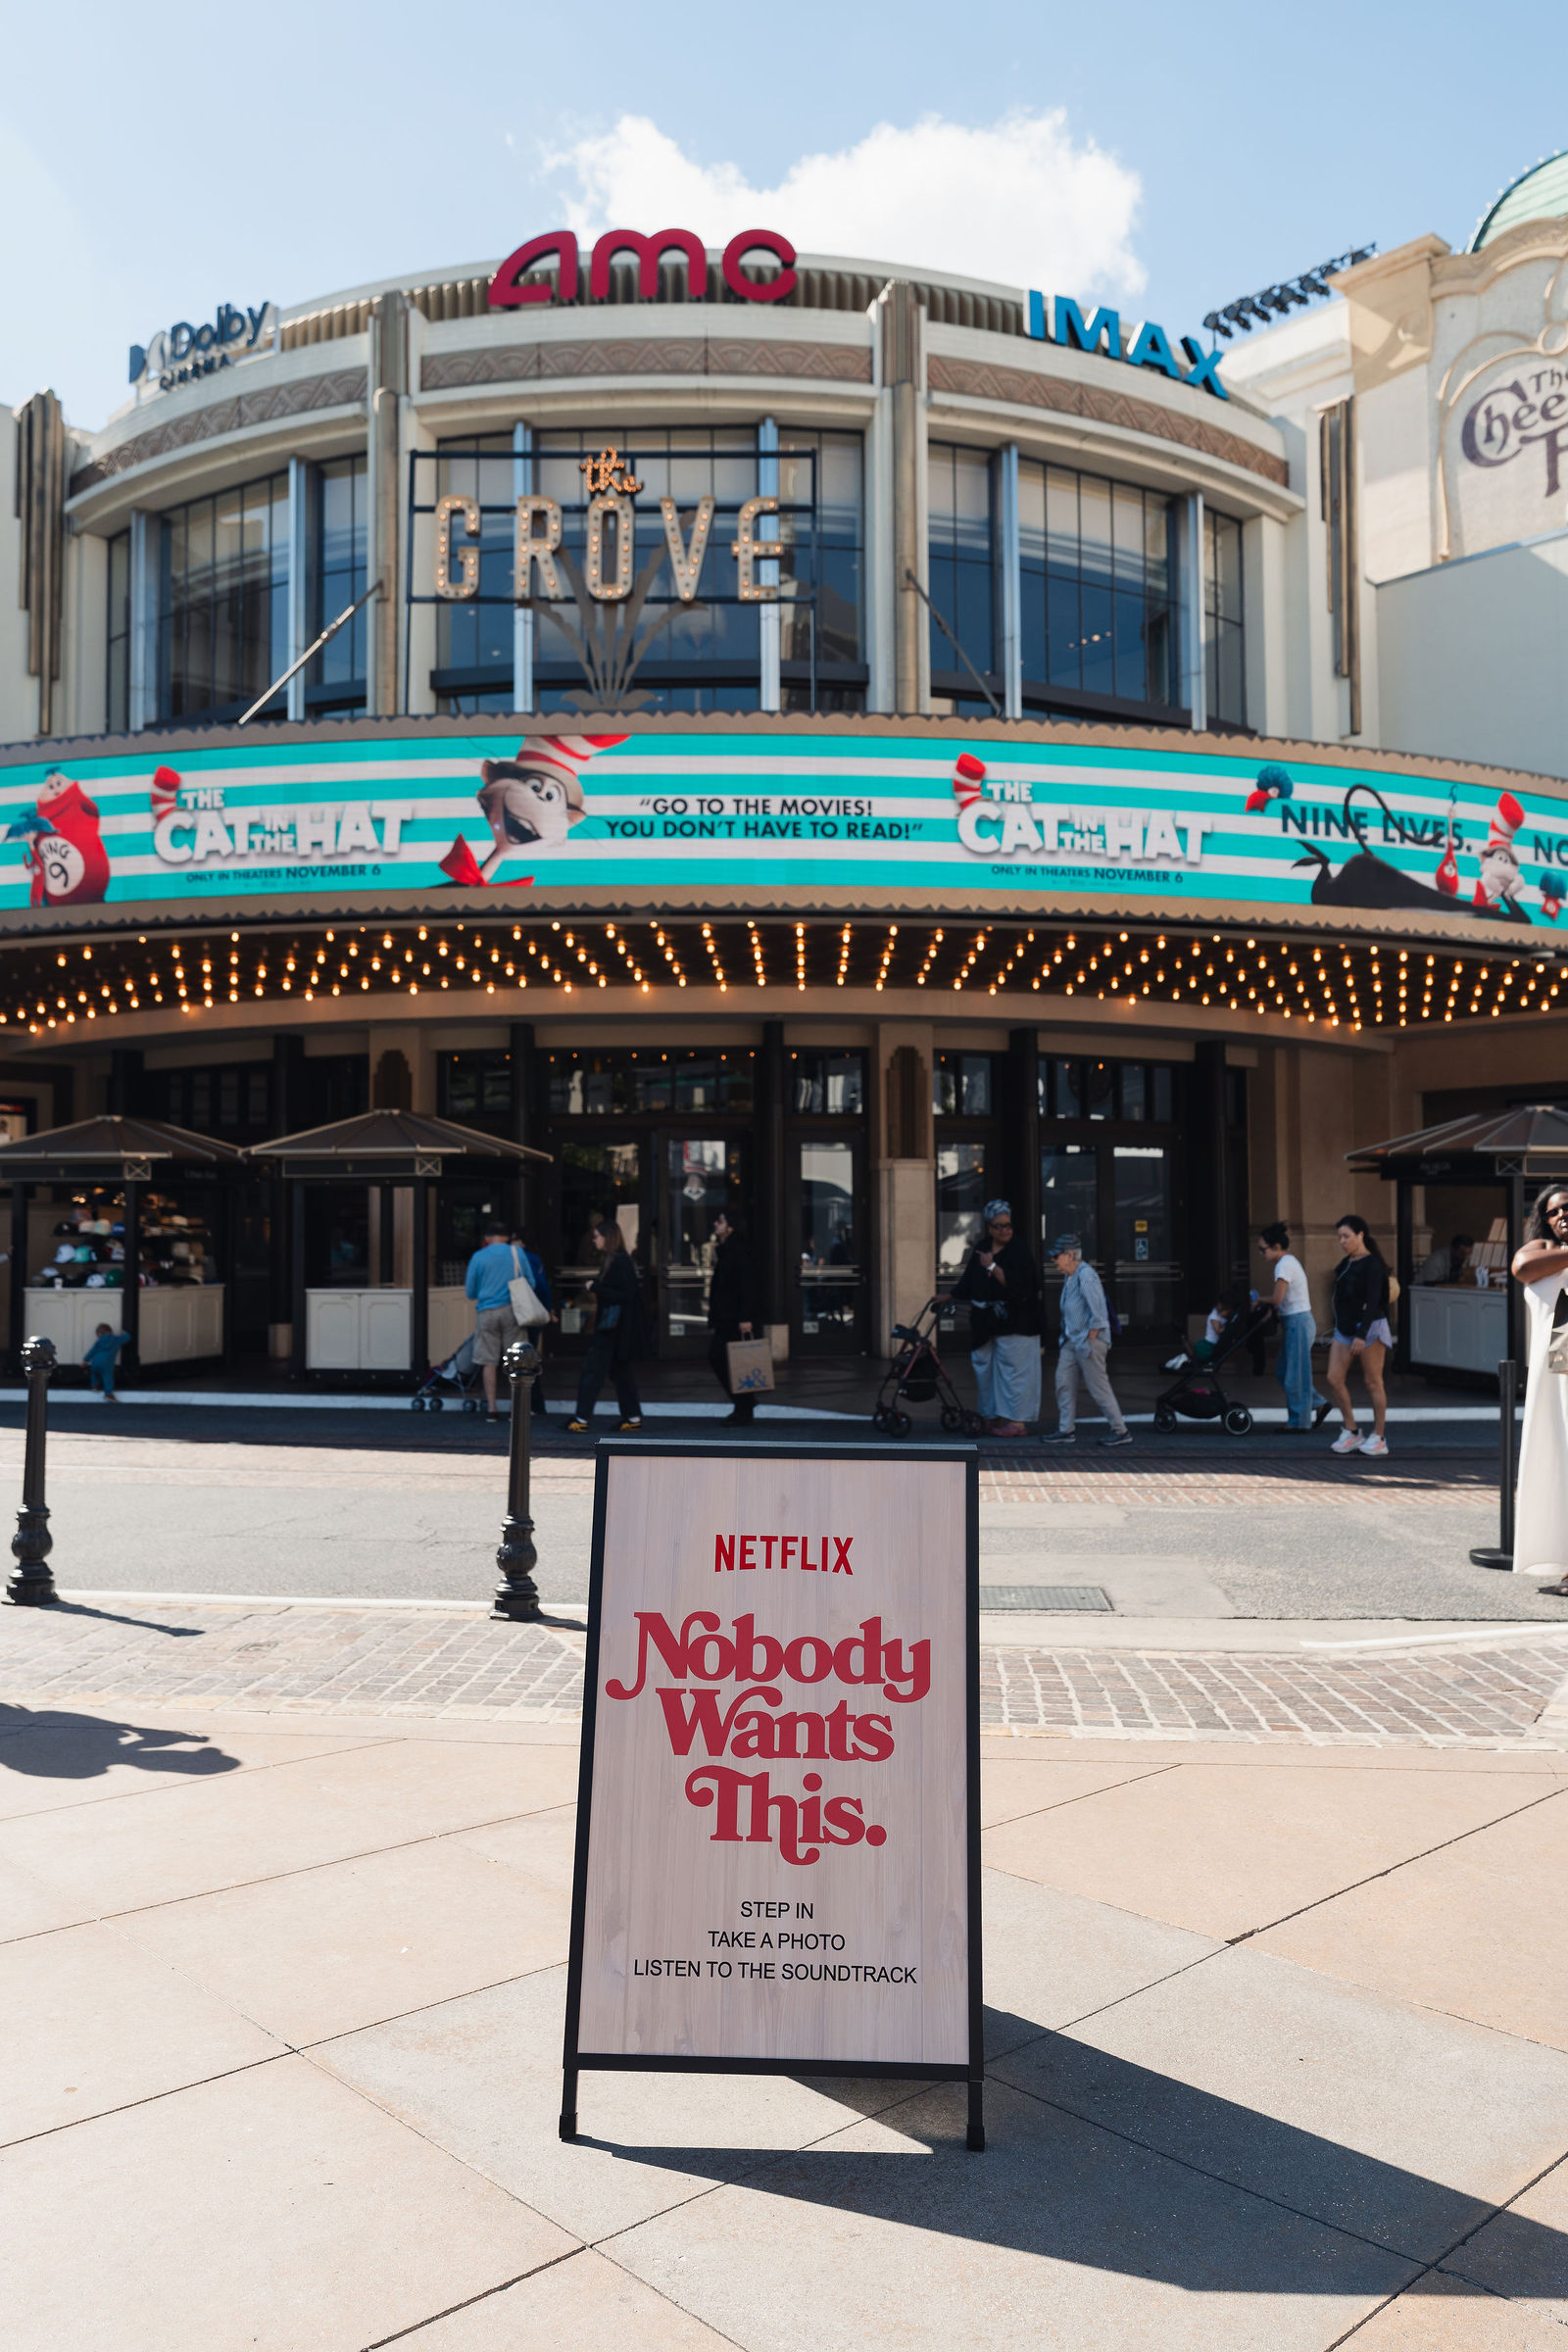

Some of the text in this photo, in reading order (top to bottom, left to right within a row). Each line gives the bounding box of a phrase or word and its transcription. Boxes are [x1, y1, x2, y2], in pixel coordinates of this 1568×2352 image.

[171, 301, 269, 347] Dolby
[1023, 289, 1229, 400] IMAX
[1529, 368, 1568, 394] Th
[580, 447, 643, 492] the
[435, 495, 783, 601] GROVE
[181, 788, 225, 809] THE
[640, 798, 872, 816] “GO TO THE MOVIES!
[986, 781, 1032, 802] THE
[154, 800, 413, 863] CAT IN THE HAT
[606, 820, 923, 840] YOU DON’T HAVE TO READ!”
[957, 803, 1212, 863] CAT IN THE HAT
[1281, 805, 1472, 853] NINE LIVES.
[49, 862, 69, 888] 9
[186, 864, 381, 883] ONLY IN THEATERS NOVEMBER 6
[991, 865, 1184, 883] ONLY IN THEATERS NOVEMBER 6
[714, 1535, 854, 1575] NETFLIX
[605, 1611, 931, 1703] Nobody
[656, 1686, 895, 1762] Wants
[685, 1765, 887, 1866] This.
[741, 1901, 813, 1919] STEP IN
[708, 1931, 846, 1950] TAKE A PHOTO
[634, 1959, 917, 1984] LISTEN TO THE SOUNDTRACK
